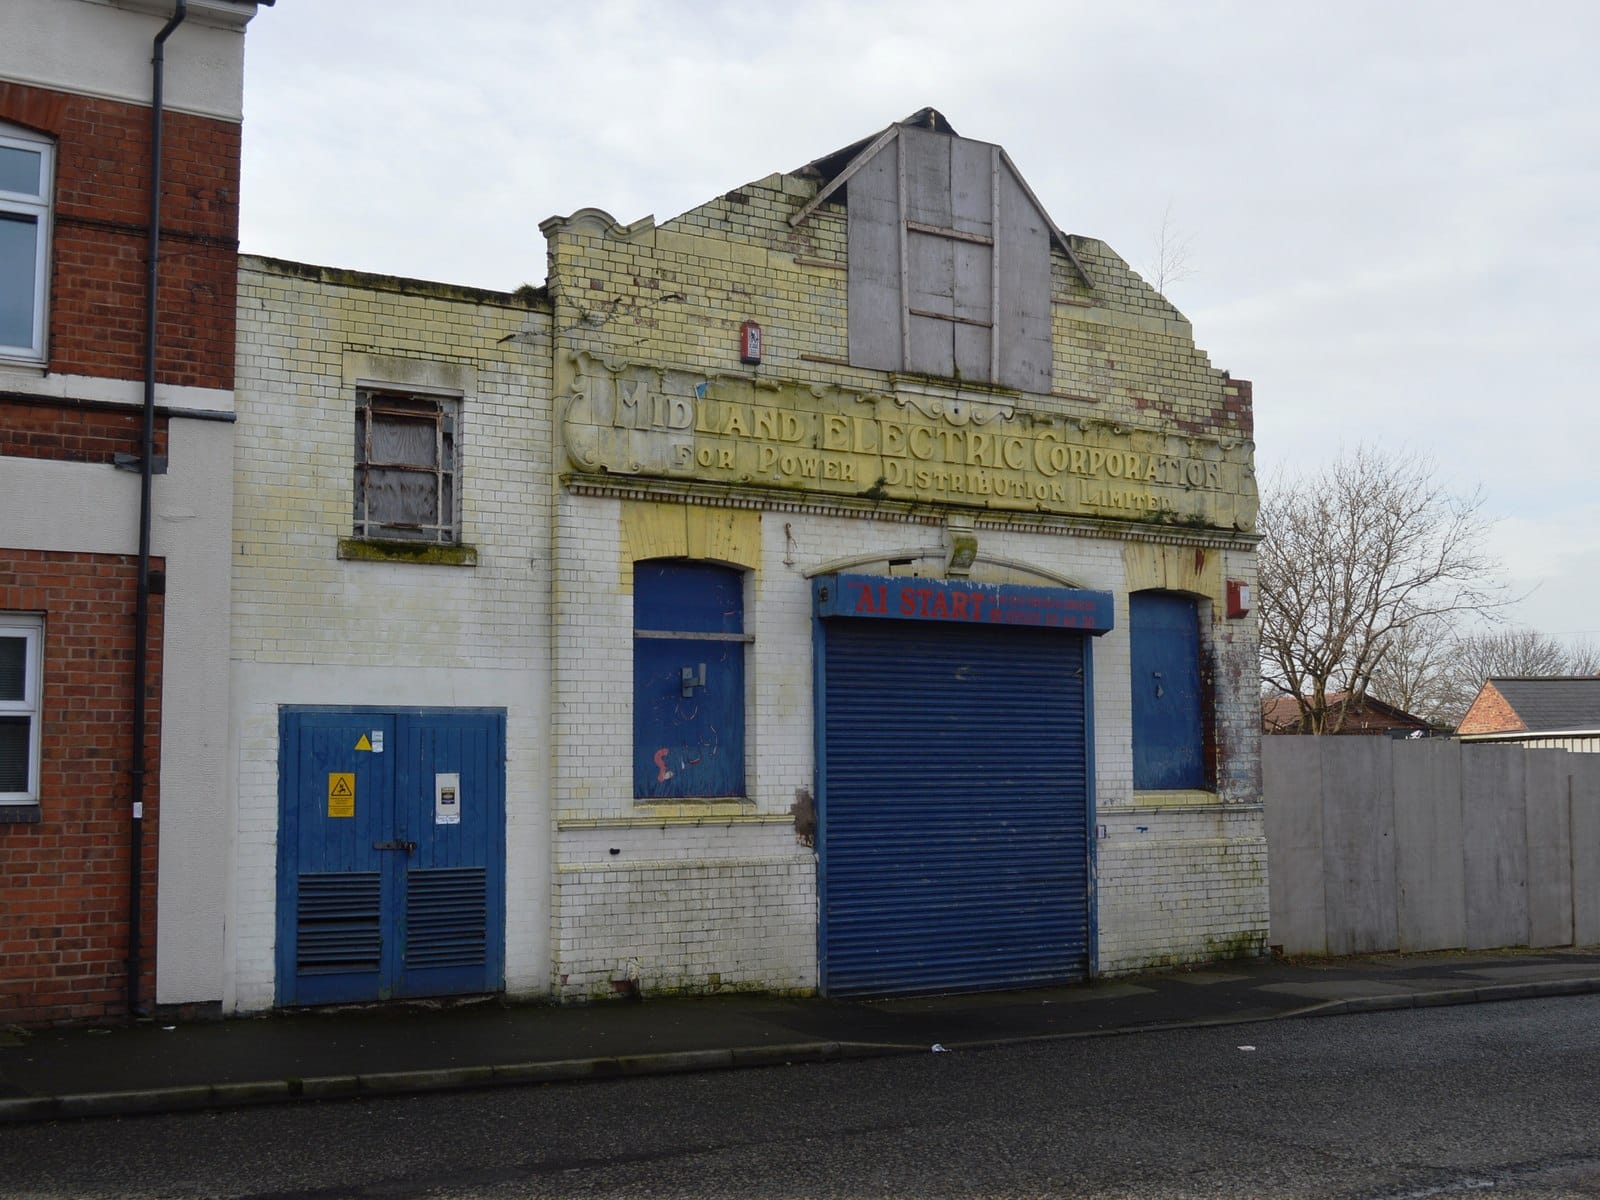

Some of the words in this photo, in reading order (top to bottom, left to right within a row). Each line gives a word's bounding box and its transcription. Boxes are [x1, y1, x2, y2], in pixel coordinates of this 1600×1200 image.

[613, 378, 802, 443] MIDLAND
[822, 413, 1024, 470] ELECTRIC
[1034, 430, 1222, 490] CORPORATION
[673, 444, 737, 470] FOR
[757, 446, 856, 482] POWER
[882, 456, 1065, 502] DISTRIBUTION
[1080, 477, 1173, 511] LIMITED
[900, 587, 986, 621] START
